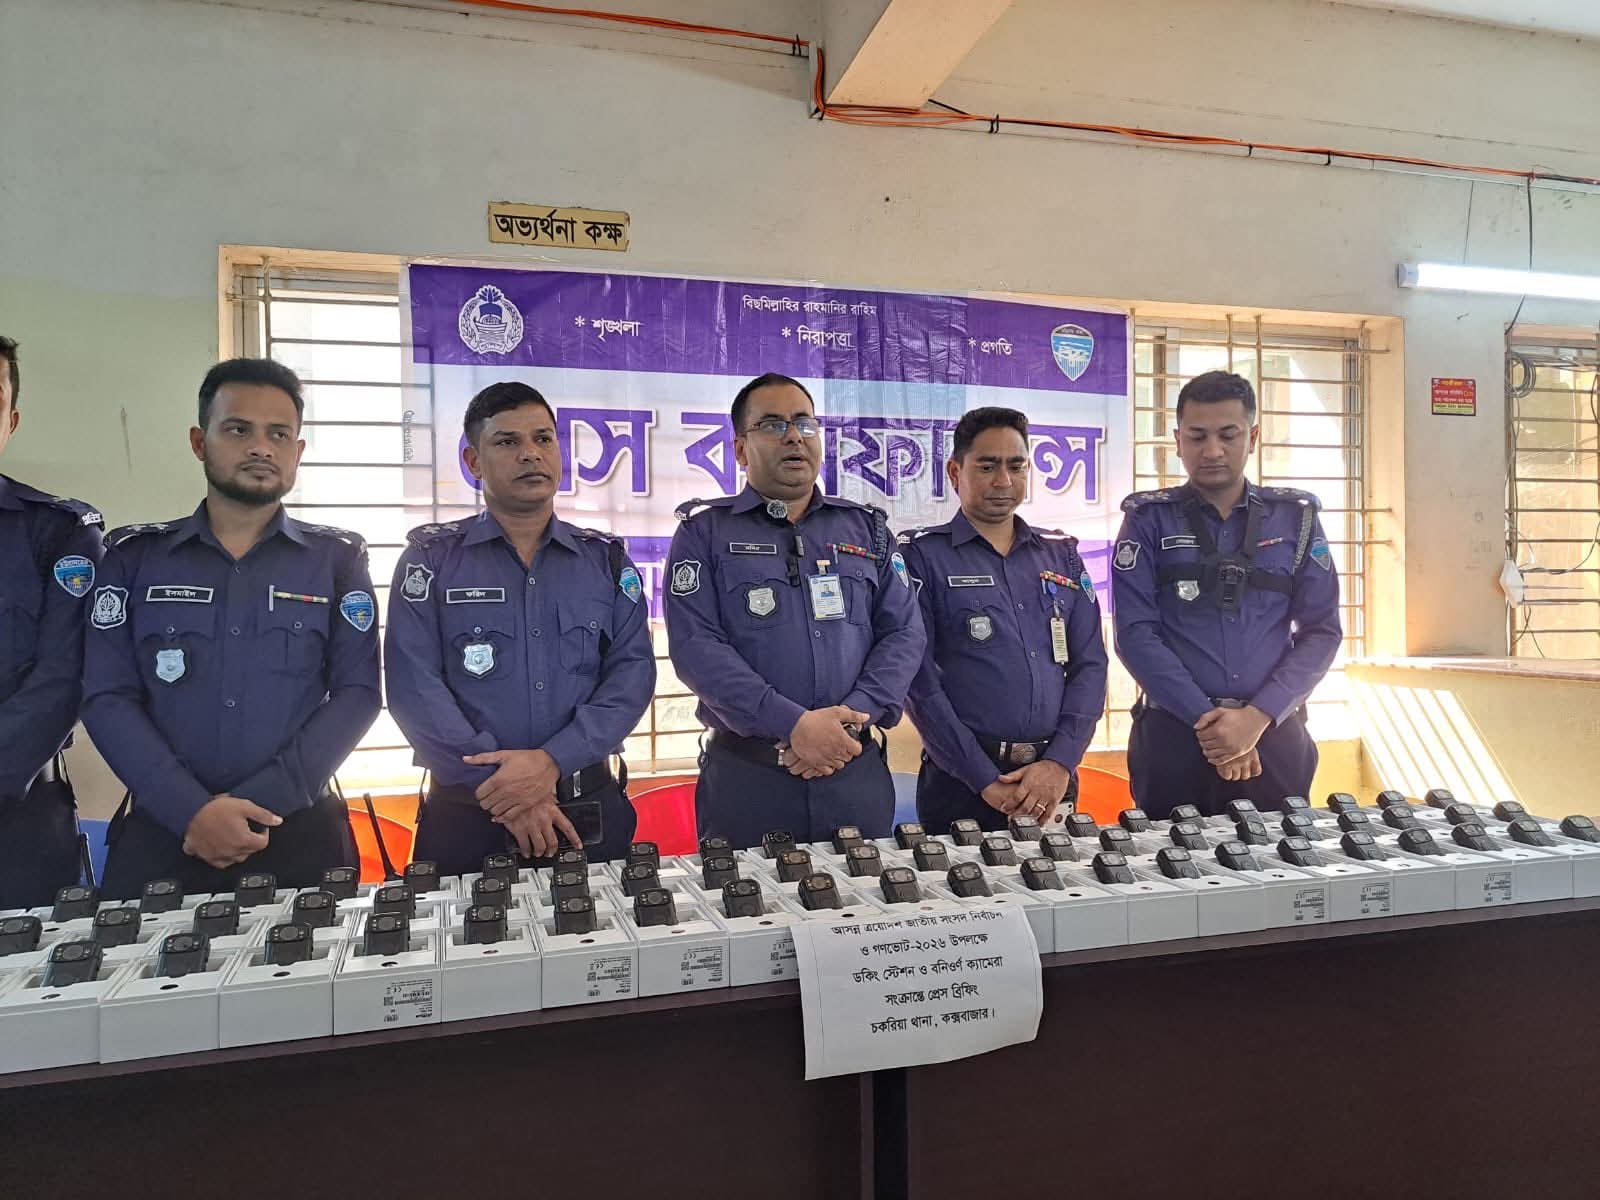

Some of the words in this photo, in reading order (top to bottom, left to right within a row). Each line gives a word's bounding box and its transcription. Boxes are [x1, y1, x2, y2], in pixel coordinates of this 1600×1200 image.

[493, 209, 577, 243] অভ্যর্থনা
[582, 220, 625, 246] কক্ষ
[742, 294, 800, 313] বিছমিল্লাহির
[802, 300, 848, 315] রাহমানির
[850, 302, 878, 316] রাহিম
[981, 337, 1013, 355] প্রগতি
[860, 946, 869, 956] ও
[872, 938, 947, 956] গণভোট-২০২৬
[949, 933, 989, 947] উপলক্ষে
[852, 967, 880, 983] ডকিং
[883, 965, 915, 980] স্টেশন
[918, 966, 928, 975] ও
[965, 956, 1003, 971] ক্যামেরা
[928, 987, 949, 1001] প্রেস
[951, 982, 980, 999] ব্রিফিং
[870, 1016, 908, 1033] চকরিয়া
